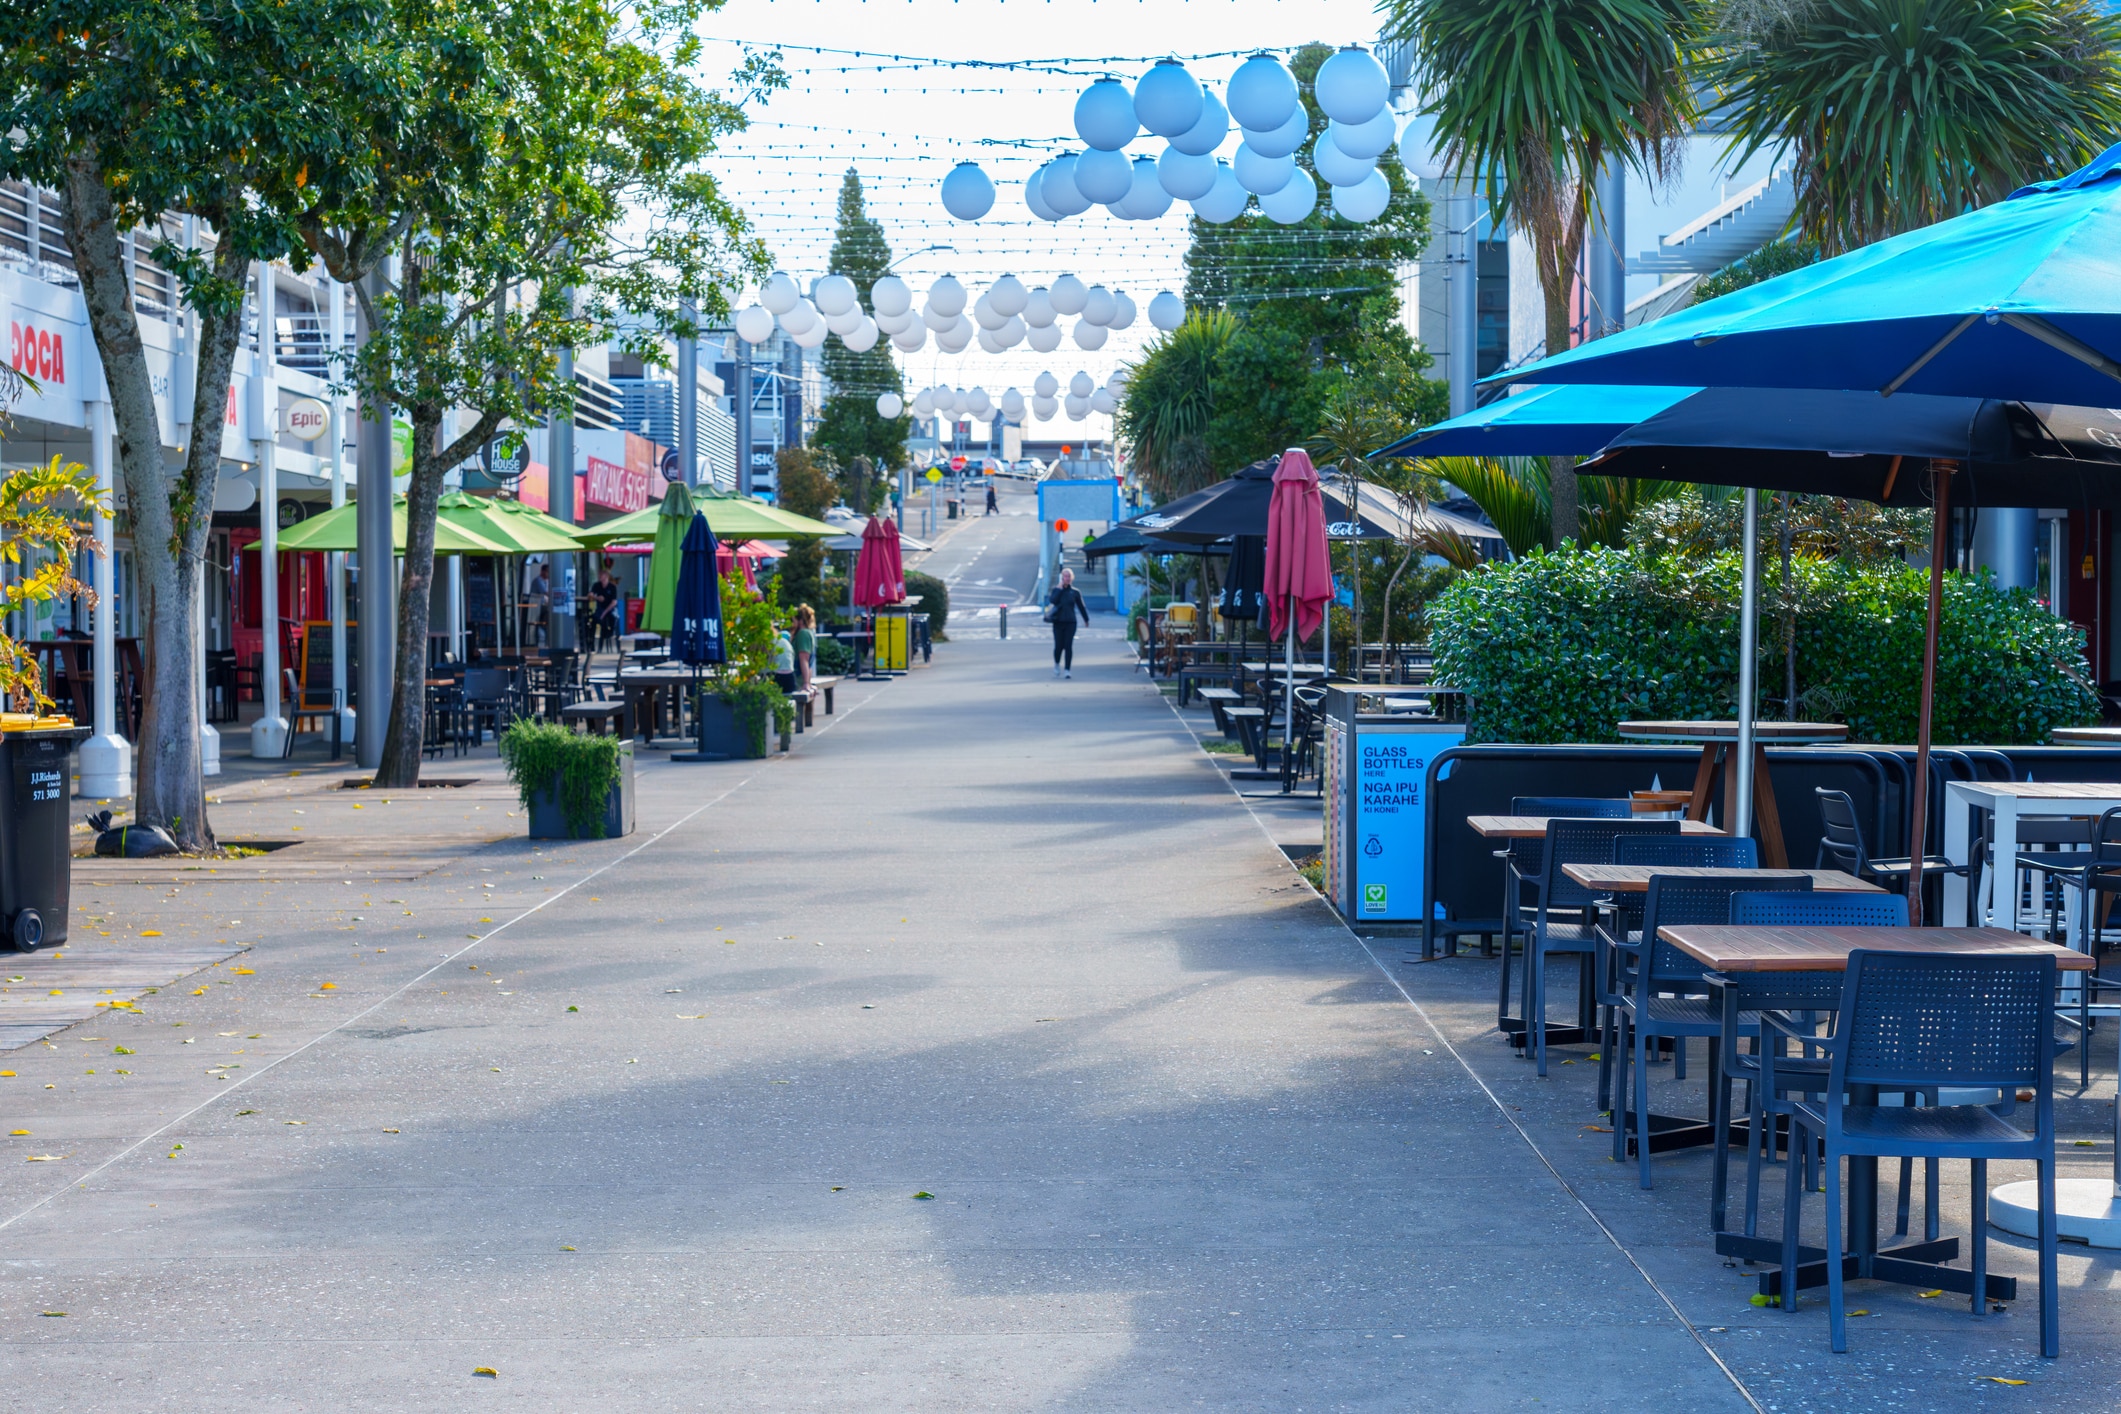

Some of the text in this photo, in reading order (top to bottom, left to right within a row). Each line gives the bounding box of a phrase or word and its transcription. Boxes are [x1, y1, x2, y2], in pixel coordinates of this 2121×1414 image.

[291, 411, 322, 428] Epic
[491, 459, 520, 470] HOUSE
[1363, 746, 1407, 757] GLASS
[1363, 758, 1424, 769] BOTTLES
[1363, 782, 1418, 793] NGA IPU
[33, 789, 61, 801] 571 3000
[1364, 795, 1419, 806] KARAHE
